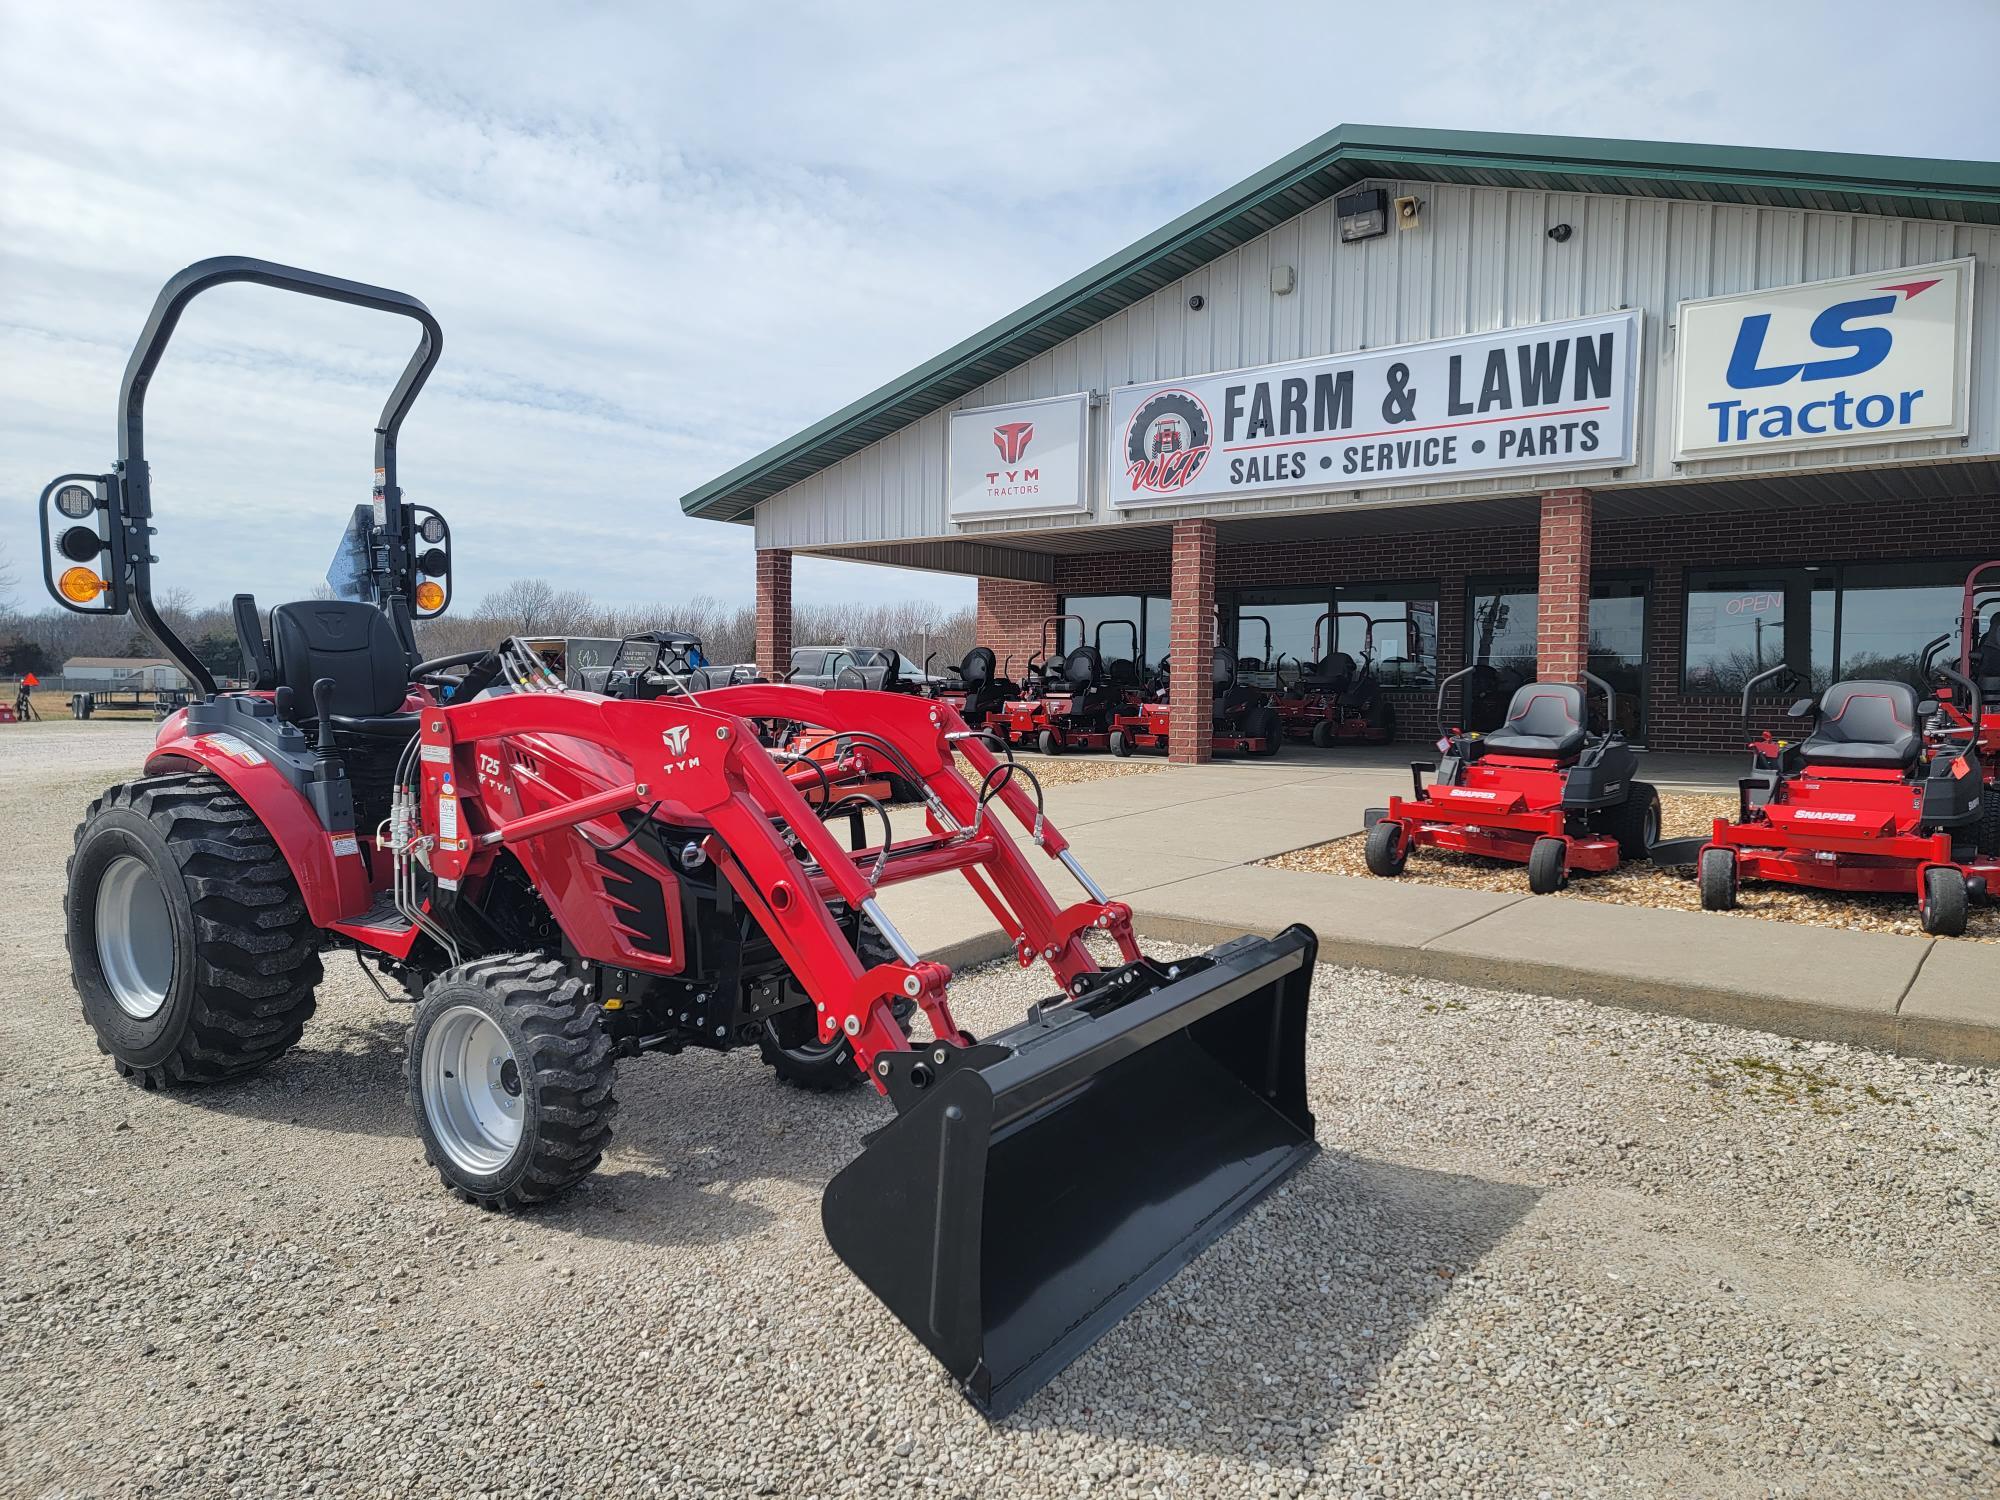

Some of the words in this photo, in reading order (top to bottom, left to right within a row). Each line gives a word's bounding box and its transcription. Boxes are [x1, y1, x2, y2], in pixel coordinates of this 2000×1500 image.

[1726, 295, 1897, 389] LS
[1223, 370, 1355, 442] FARM
[1382, 362, 1417, 423] &
[1447, 332, 1615, 417] LAWN
[1708, 390, 1924, 442] Tractor
[1230, 450, 1306, 484] SALES
[1342, 435, 1457, 474] SERVICE
[1498, 420, 1600, 459] PARTS
[986, 468, 1040, 485] TYM
[1126, 446, 1210, 491] WCT
[987, 485, 1039, 497] TRACTORS
[1726, 592, 1784, 615] OPEN
[480, 753, 500, 776] T25
[663, 756, 700, 774] TYM
[1450, 788, 1497, 800] SNAPPER
[1793, 809, 1857, 823] SNAPPER
